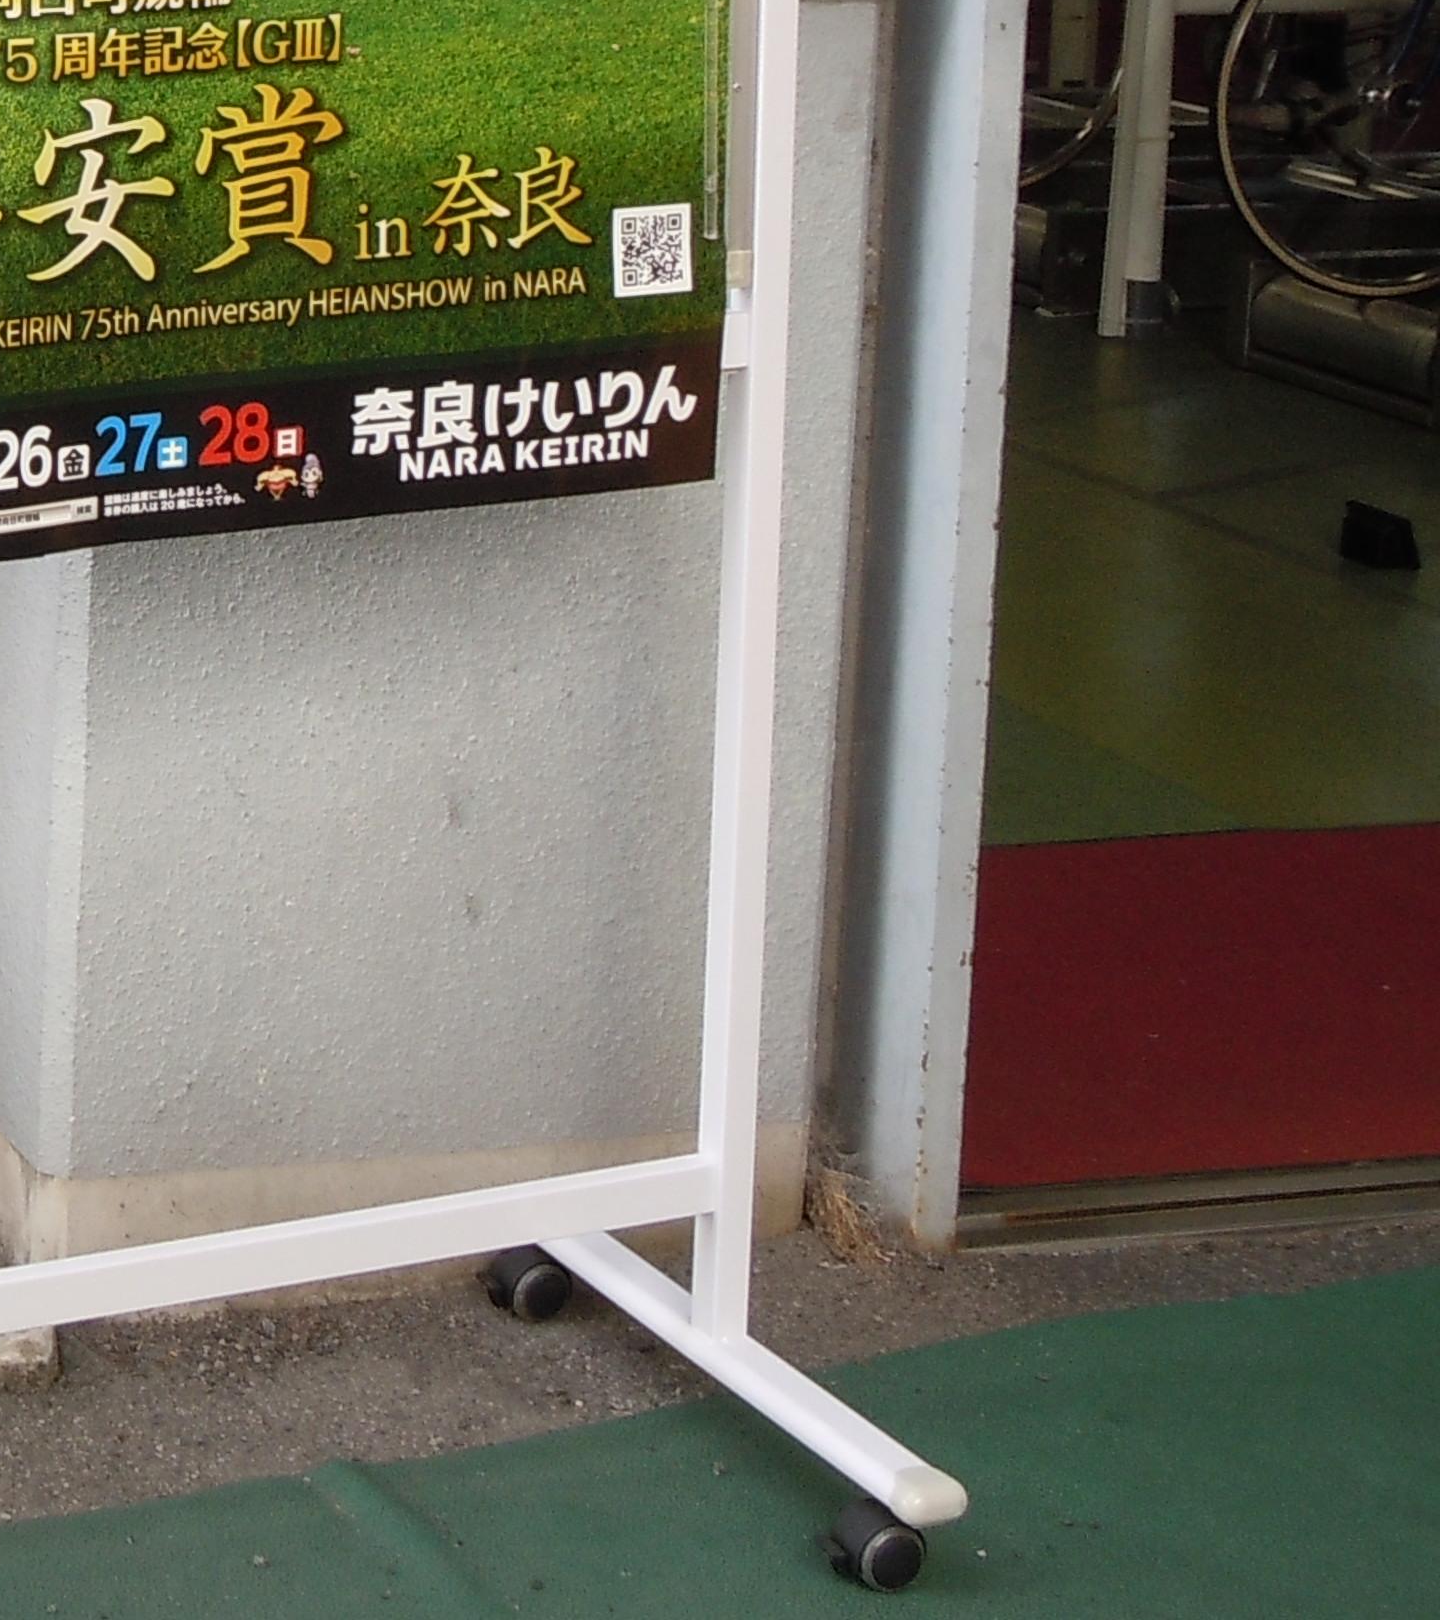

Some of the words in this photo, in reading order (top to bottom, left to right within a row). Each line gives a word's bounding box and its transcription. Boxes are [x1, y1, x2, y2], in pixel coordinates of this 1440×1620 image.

[353, 204, 412, 260] in
[422, 146, 592, 257] 奈良
[79, 305, 140, 341] 75th
[146, 294, 303, 331] Anniversary
[308, 276, 473, 317] HEIANSHOW
[484, 275, 507, 302] in
[514, 266, 587, 299] NARA
[94, 412, 162, 477] 27
[199, 401, 270, 467] 28
[351, 365, 697, 456] 奈良けいりん
[399, 447, 507, 482] NARA
[514, 428, 650, 472] KEIRIN
